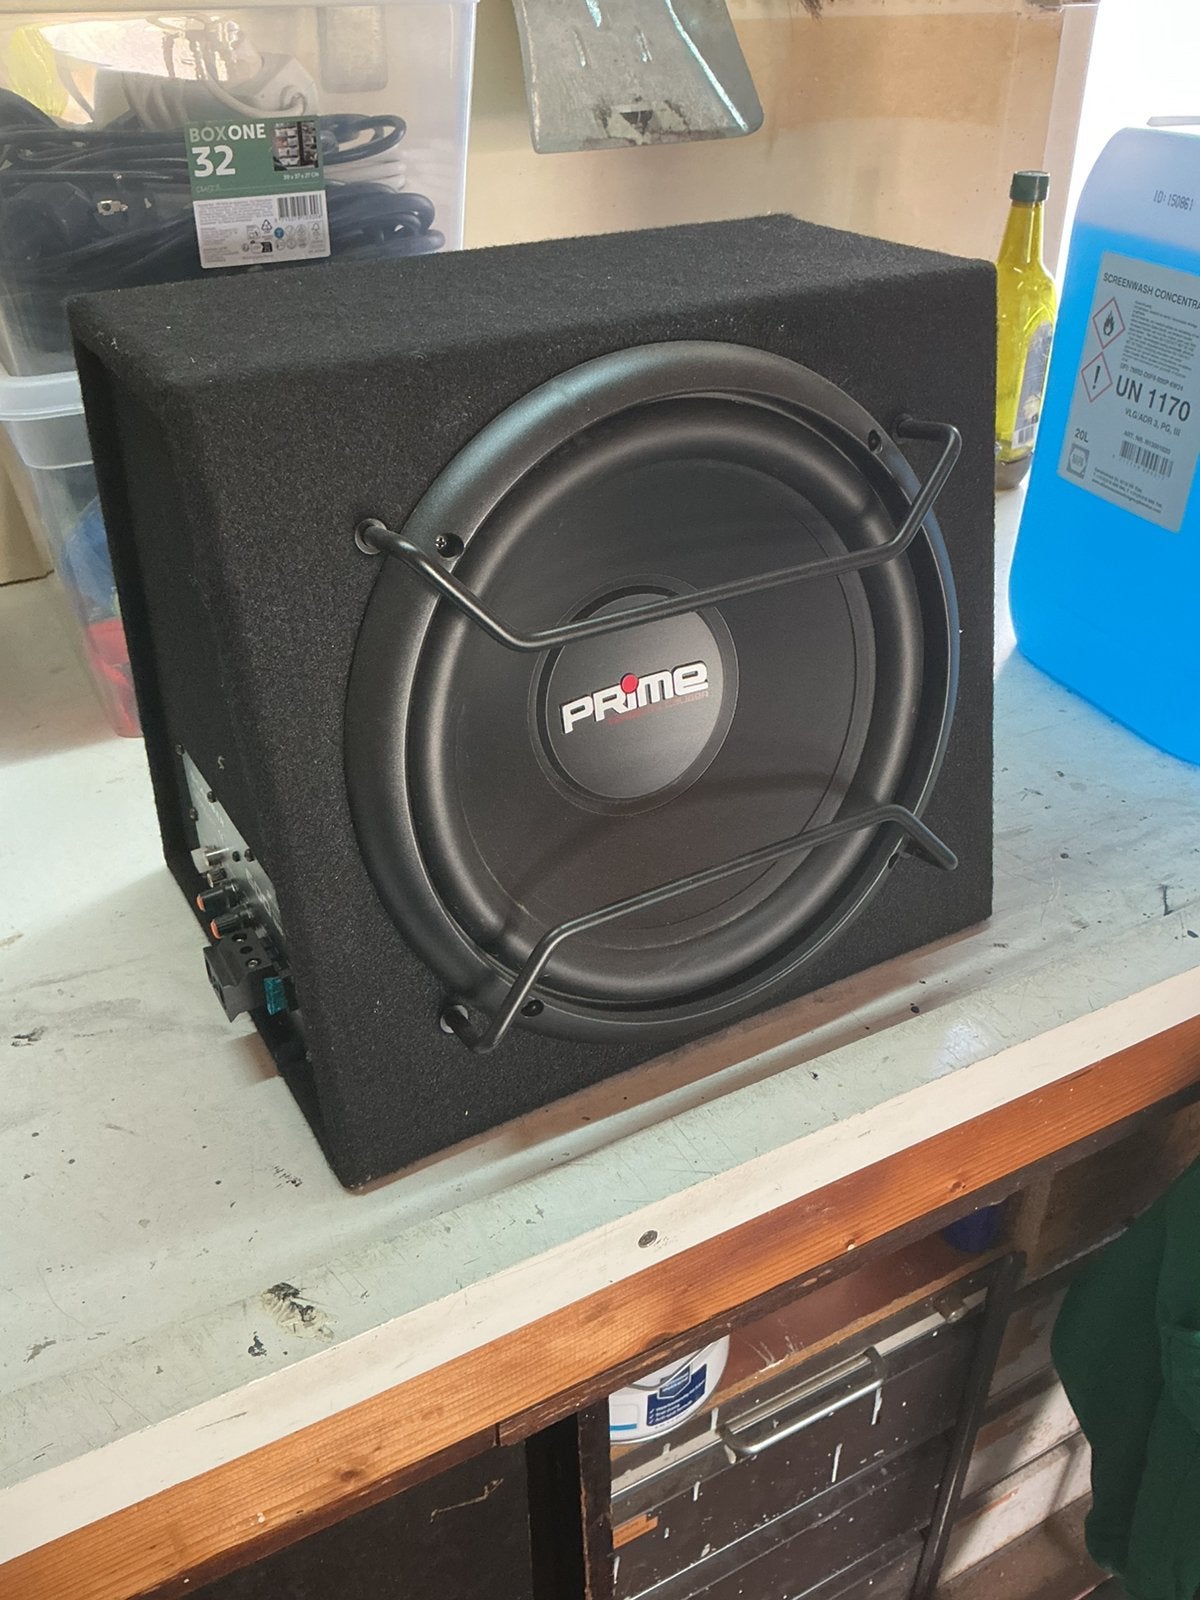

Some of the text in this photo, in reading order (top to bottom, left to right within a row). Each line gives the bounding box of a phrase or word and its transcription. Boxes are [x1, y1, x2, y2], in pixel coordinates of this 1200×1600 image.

[189, 123, 267, 143] BOXONE
[191, 144, 236, 178] 32
[1103, 272, 1153, 296] SCREENWASH
[1115, 374, 1143, 404] UN
[1148, 388, 1192, 422] 1170
[1074, 427, 1089, 443] 20L
